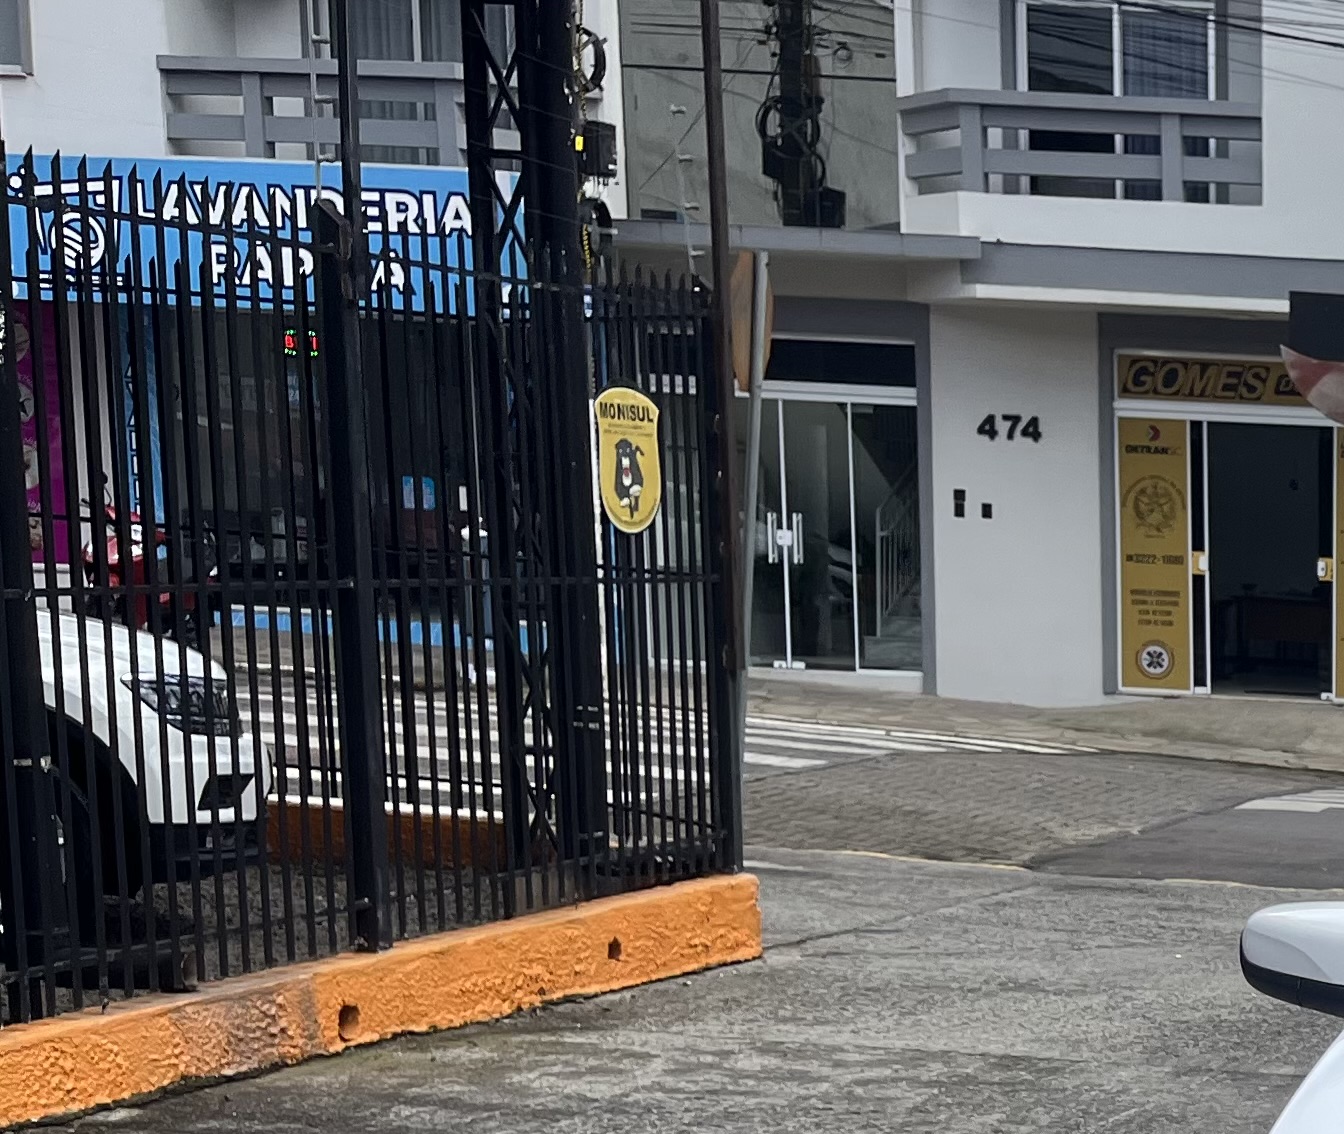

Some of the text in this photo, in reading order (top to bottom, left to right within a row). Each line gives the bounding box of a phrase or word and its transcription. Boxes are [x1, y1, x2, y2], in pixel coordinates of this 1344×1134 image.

[136, 179, 473, 237] LAVANDERIA
[1122, 359, 1270, 400] GOMES
[599, 401, 654, 423] MONISUL
[976, 413, 1043, 443] 474
